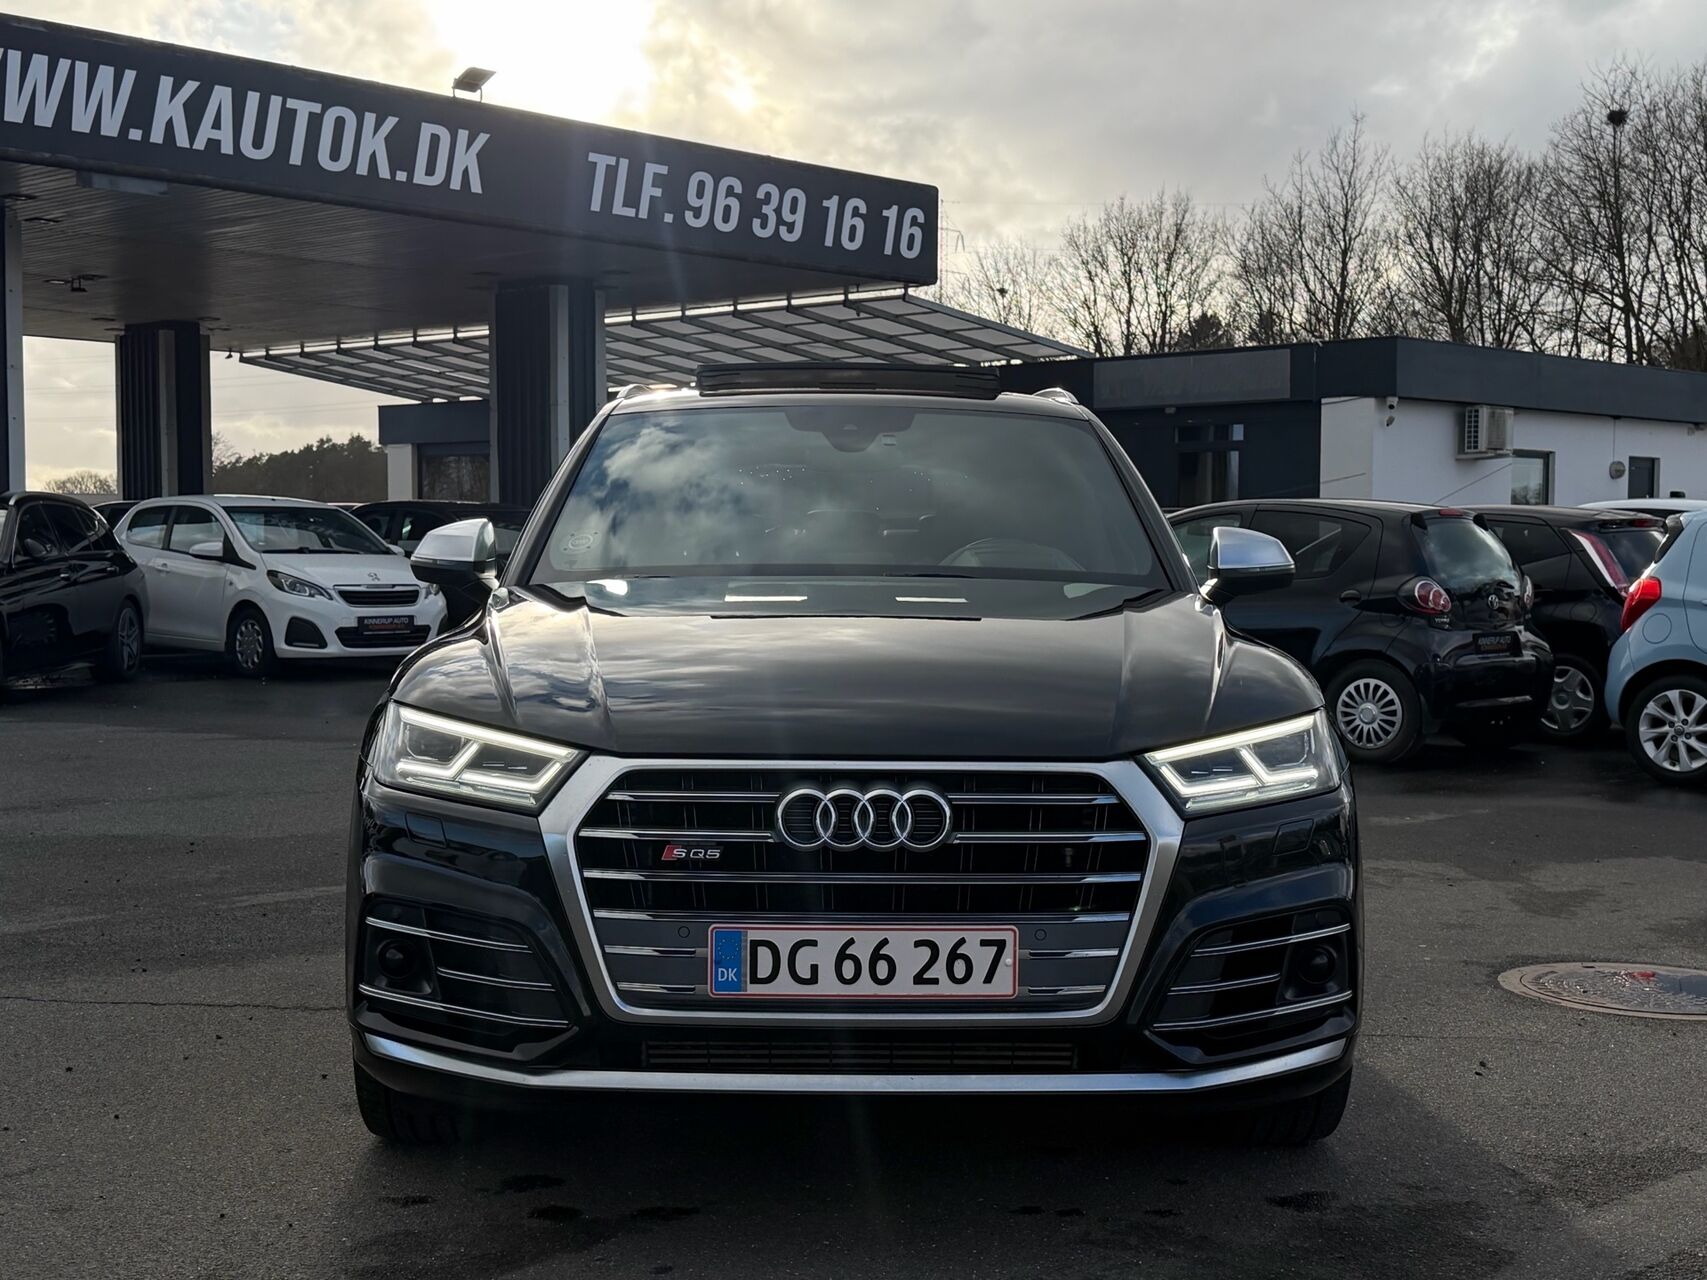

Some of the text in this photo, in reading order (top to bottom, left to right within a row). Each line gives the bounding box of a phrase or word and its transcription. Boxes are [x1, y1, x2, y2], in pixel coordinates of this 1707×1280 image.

[0, 47, 491, 195] WW.KAUTOK.DK
[588, 152, 926, 259] TLF. 96 39 16 16
[672, 848, 721, 859] SQ5
[717, 967, 738, 982] DK
[748, 936, 1007, 986] DG 66 267
